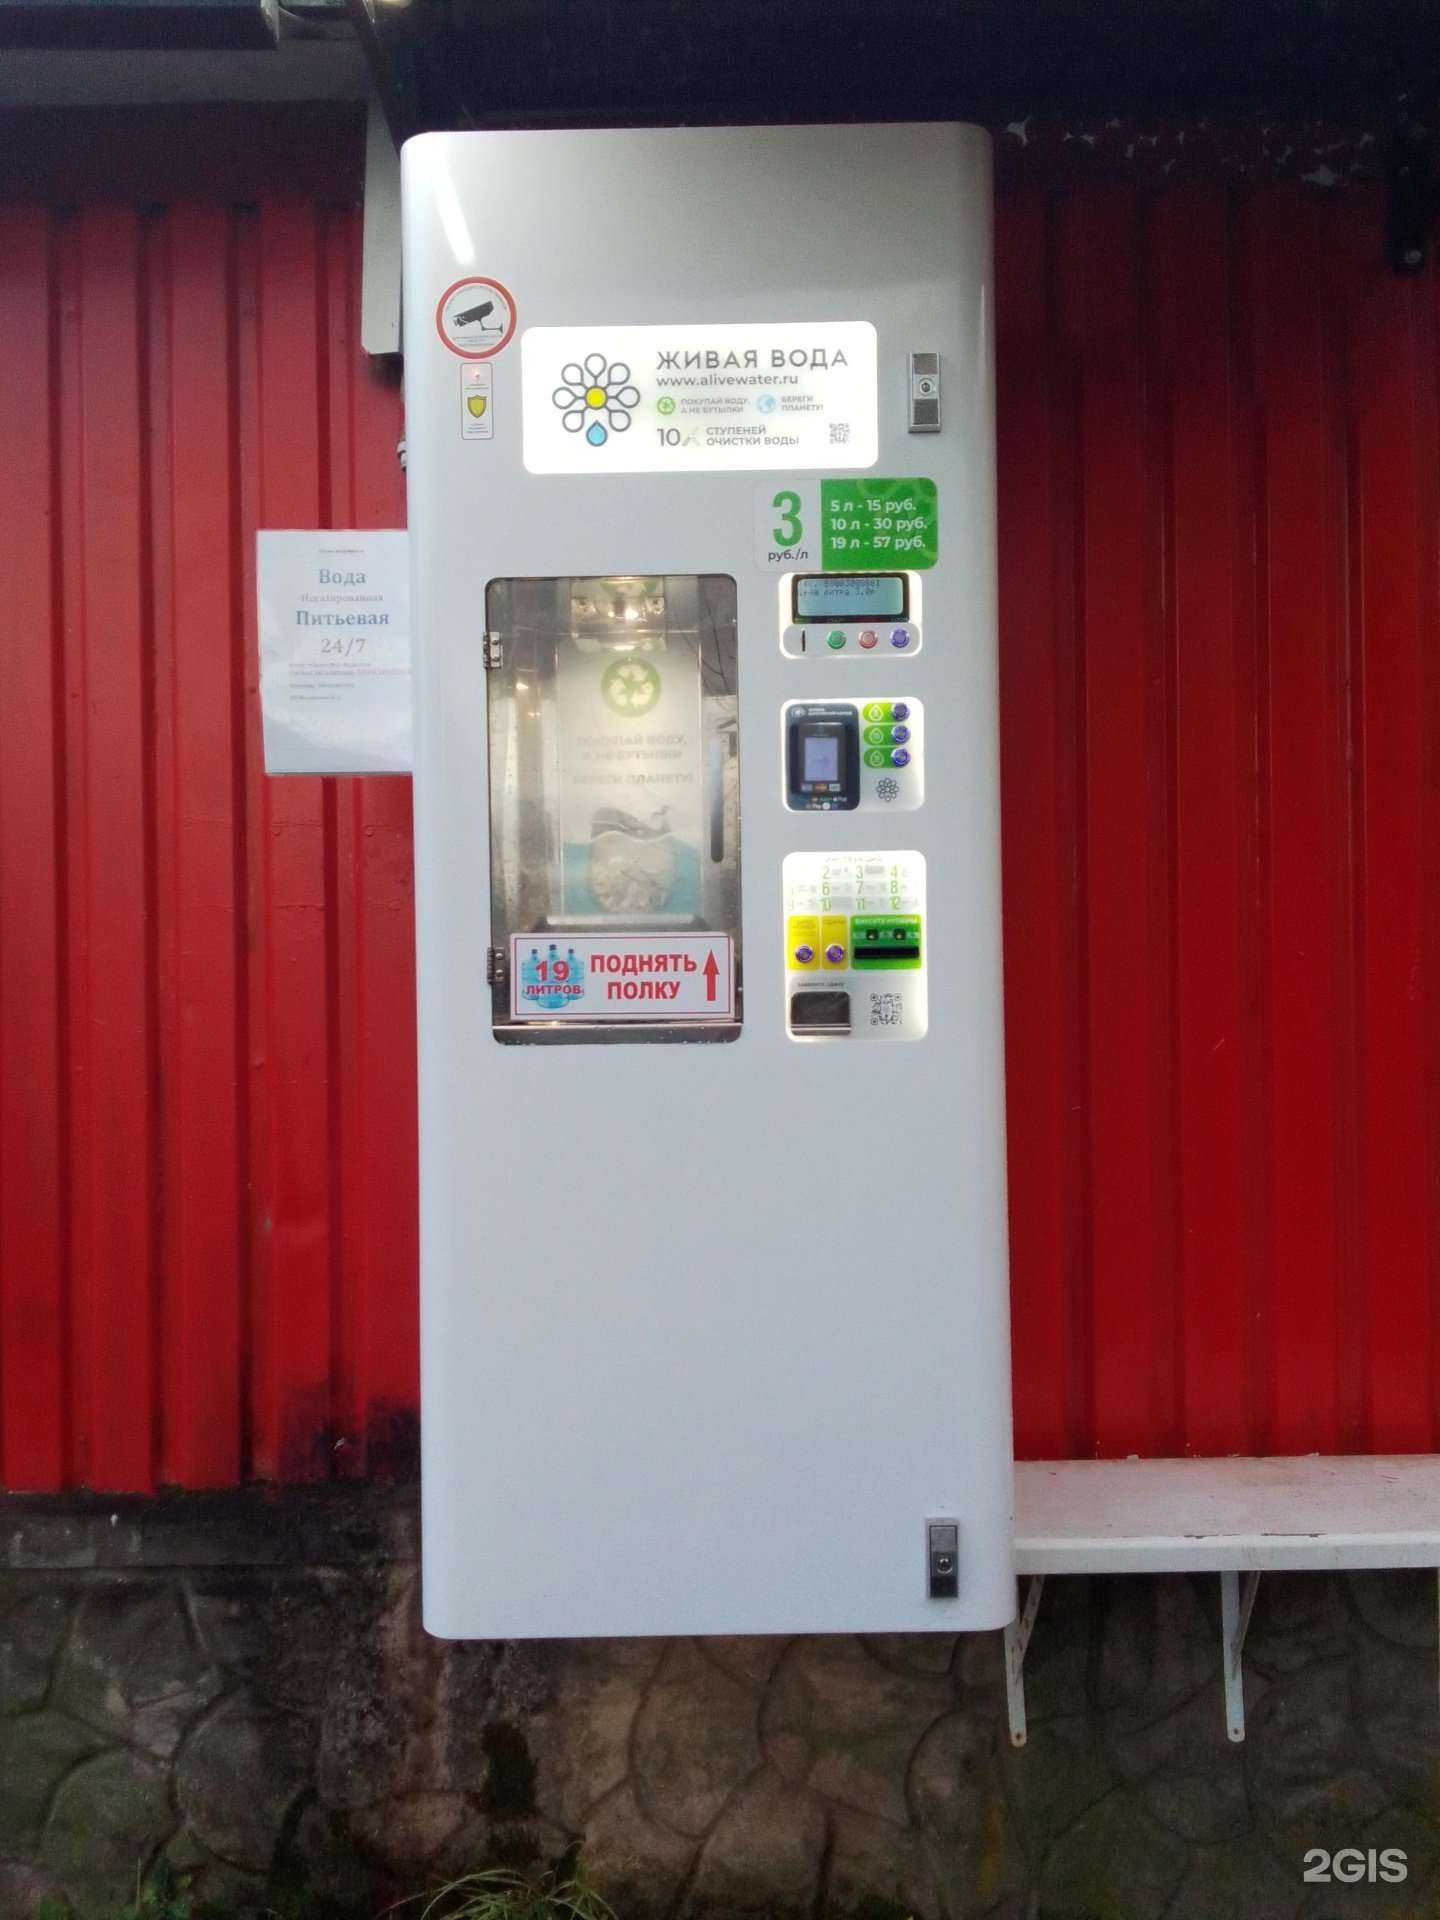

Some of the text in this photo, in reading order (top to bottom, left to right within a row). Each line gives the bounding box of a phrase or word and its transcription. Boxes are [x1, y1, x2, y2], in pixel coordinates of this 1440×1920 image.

[656, 348, 849, 370] ЖИВАЯ ВОДА
[656, 373, 799, 387] www.alivewater.ru
[706, 424, 767, 436] СТУПЕНЕЙ
[706, 435, 800, 447] ОЧИСТКИ ВОДЫ
[830, 500, 841, 512] 5
[842, 502, 853, 512] л
[867, 500, 881, 512] 15
[885, 500, 917, 514] руб.
[772, 491, 803, 547] 3
[830, 518, 846, 530] 10
[850, 520, 860, 530] л
[873, 518, 892, 530] 30
[896, 517, 927, 532] руб.
[830, 537, 846, 549] 19
[849, 539, 860, 549] л
[873, 536, 890, 549] 57
[895, 536, 926, 551] руб.
[768, 549, 809, 563] руб./л
[318, 568, 366, 587] Вода
[295, 610, 390, 626] Питьевая
[320, 638, 367, 656] 24/7
[535, 960, 570, 982] 19
[590, 954, 698, 976] ПОДНЯТЬ
[525, 984, 582, 995] ЛИТРОВ
[607, 981, 681, 1000] ПОЛКУ
